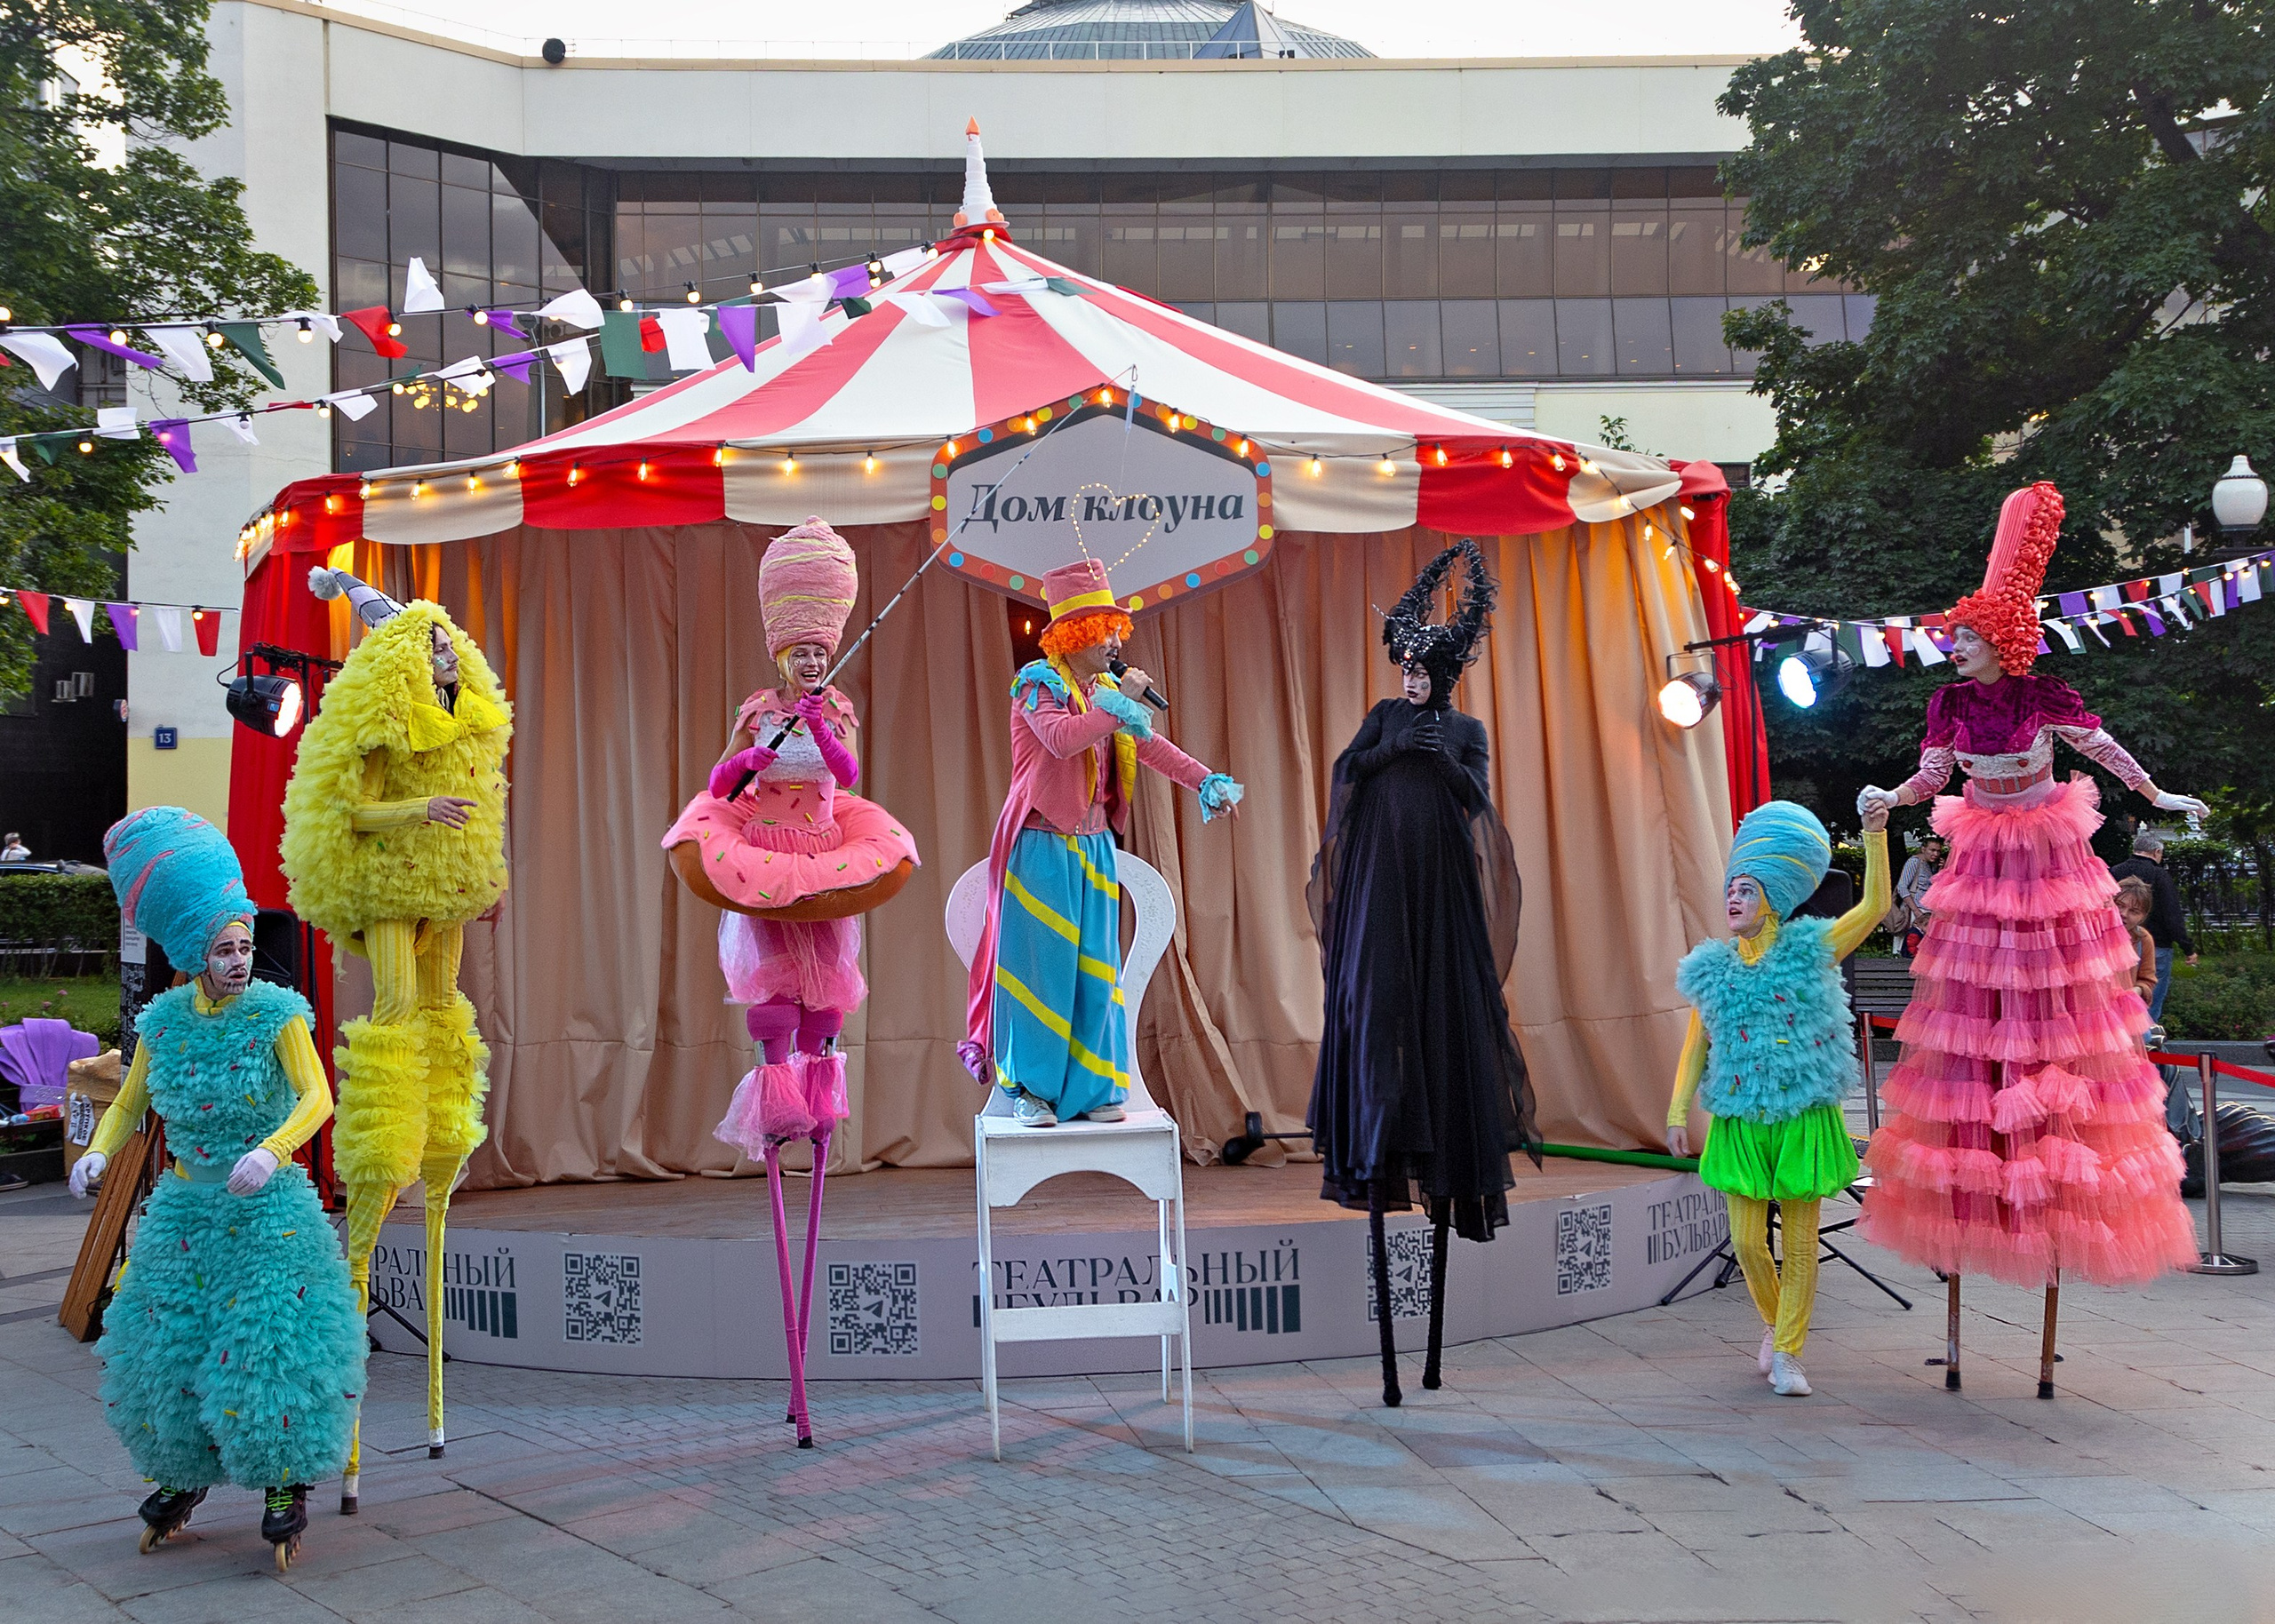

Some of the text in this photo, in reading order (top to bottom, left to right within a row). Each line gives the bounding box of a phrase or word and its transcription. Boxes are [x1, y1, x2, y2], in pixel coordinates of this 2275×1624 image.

[960, 484, 1245, 534] Дом клоуна
[158, 733, 172, 744] 13
[1662, 1213, 1726, 1262] БУЛЬВАР
[374, 1245, 516, 1288] РАЛНЫЙ
